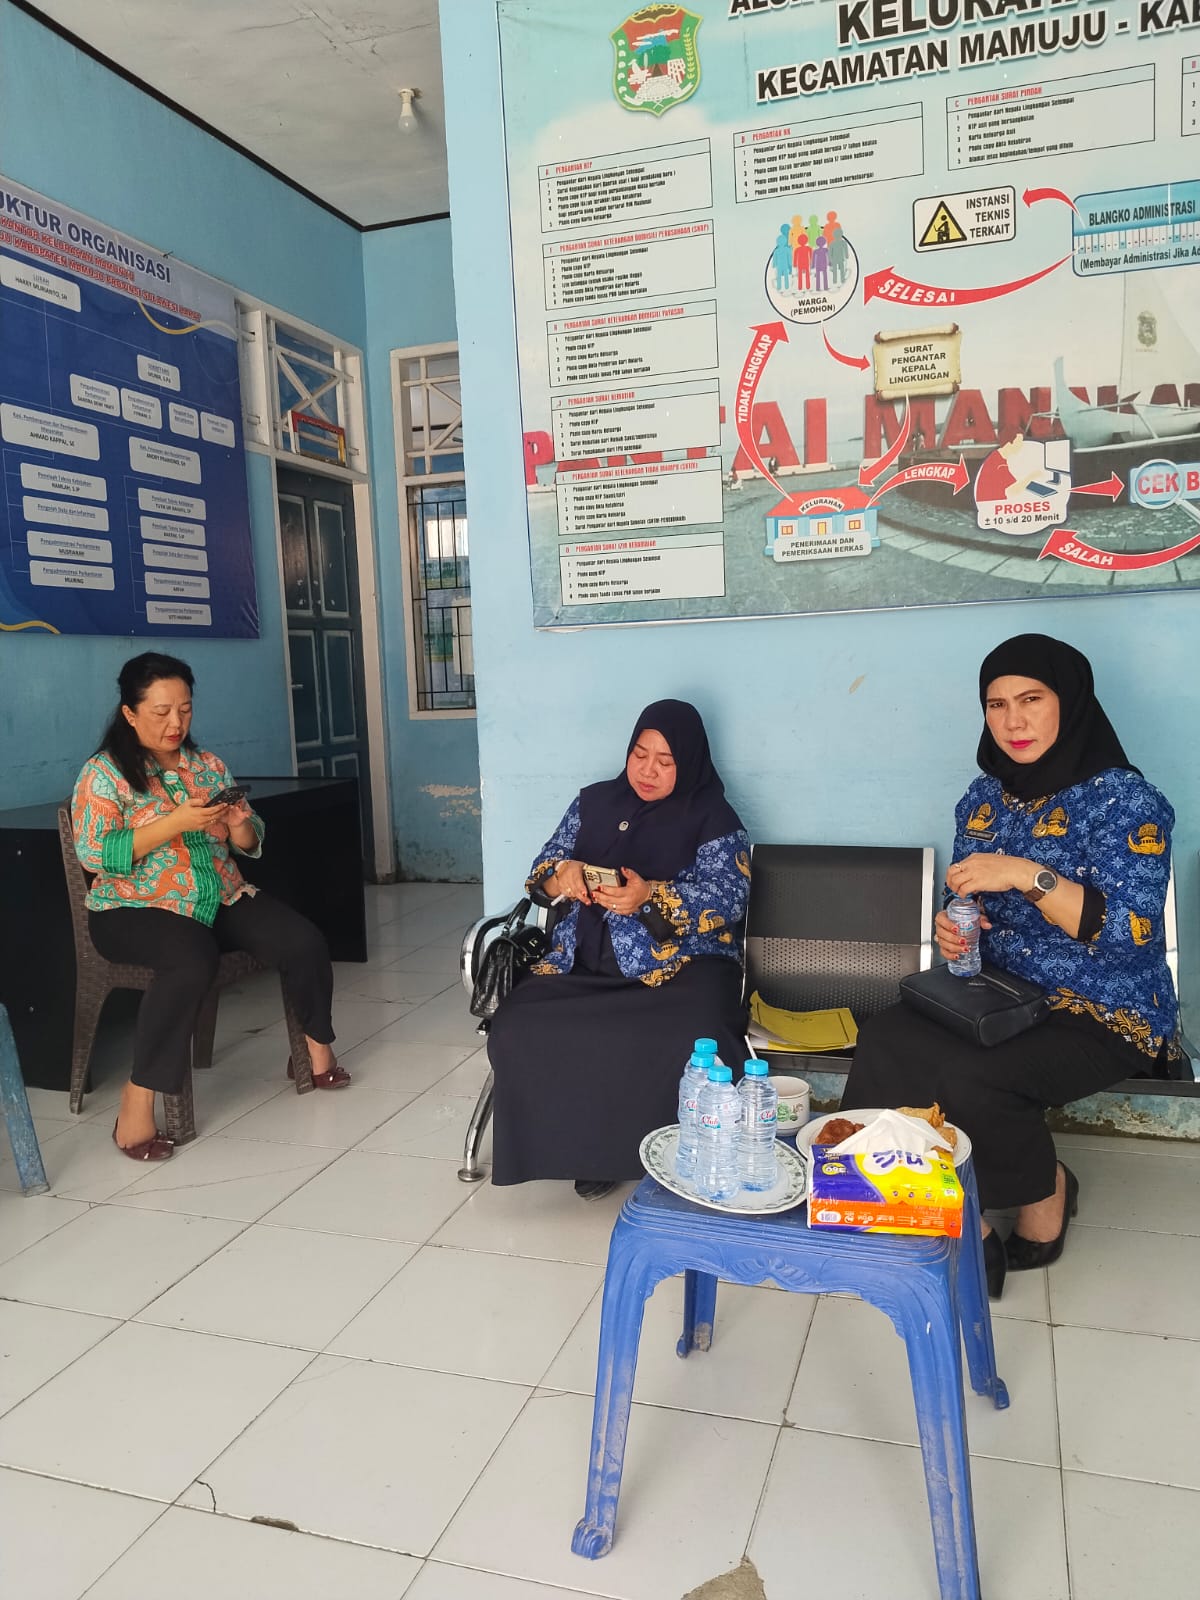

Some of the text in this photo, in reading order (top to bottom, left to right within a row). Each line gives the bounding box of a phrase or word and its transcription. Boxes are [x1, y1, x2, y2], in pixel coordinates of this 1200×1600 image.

[758, 40, 948, 99] KECAMATAN
[960, 11, 1106, 64] MAMUJU
[1001, 90, 1018, 100] SURAT
[1020, 86, 1041, 96] PINDAH
[966, 194, 1010, 209] INSTANSI
[975, 209, 1010, 223] TEKNIS
[1089, 200, 1196, 226] BLANGKO ADMINISTRASI
[969, 224, 1010, 238] TERKAIT
[67, 222, 171, 283] ORGANISASI
[1080, 255, 1121, 272] (Membayar
[1123, 248, 1171, 266] Administrasi
[1173, 247, 1189, 259] Jika
[878, 278, 955, 303] SELESAI
[798, 297, 828, 307] WARGA
[790, 304, 836, 317] (PEMOHON)
[904, 344, 933, 354] SURAT
[891, 352, 946, 365] PENGANTAR
[901, 363, 936, 374] KEPALA
[738, 334, 773, 424] TIDAK LENGKAP
[889, 371, 950, 385] LINGKUNGAN
[904, 466, 955, 480] LENGKAP
[1137, 472, 1179, 495] CEK
[801, 498, 843, 512] KELURAHAN
[995, 501, 1050, 515] PROSES
[993, 515, 1004, 525] 10
[1006, 514, 1019, 524] s/d
[1022, 514, 1032, 524] 20
[1035, 513, 1060, 523] Menit
[790, 537, 854, 548] PENERIMAAN DAN
[781, 544, 864, 557] PEMERIKSAAN BERKAS
[1058, 542, 1114, 566] SALAH
[701, 1115, 719, 1125] Club
